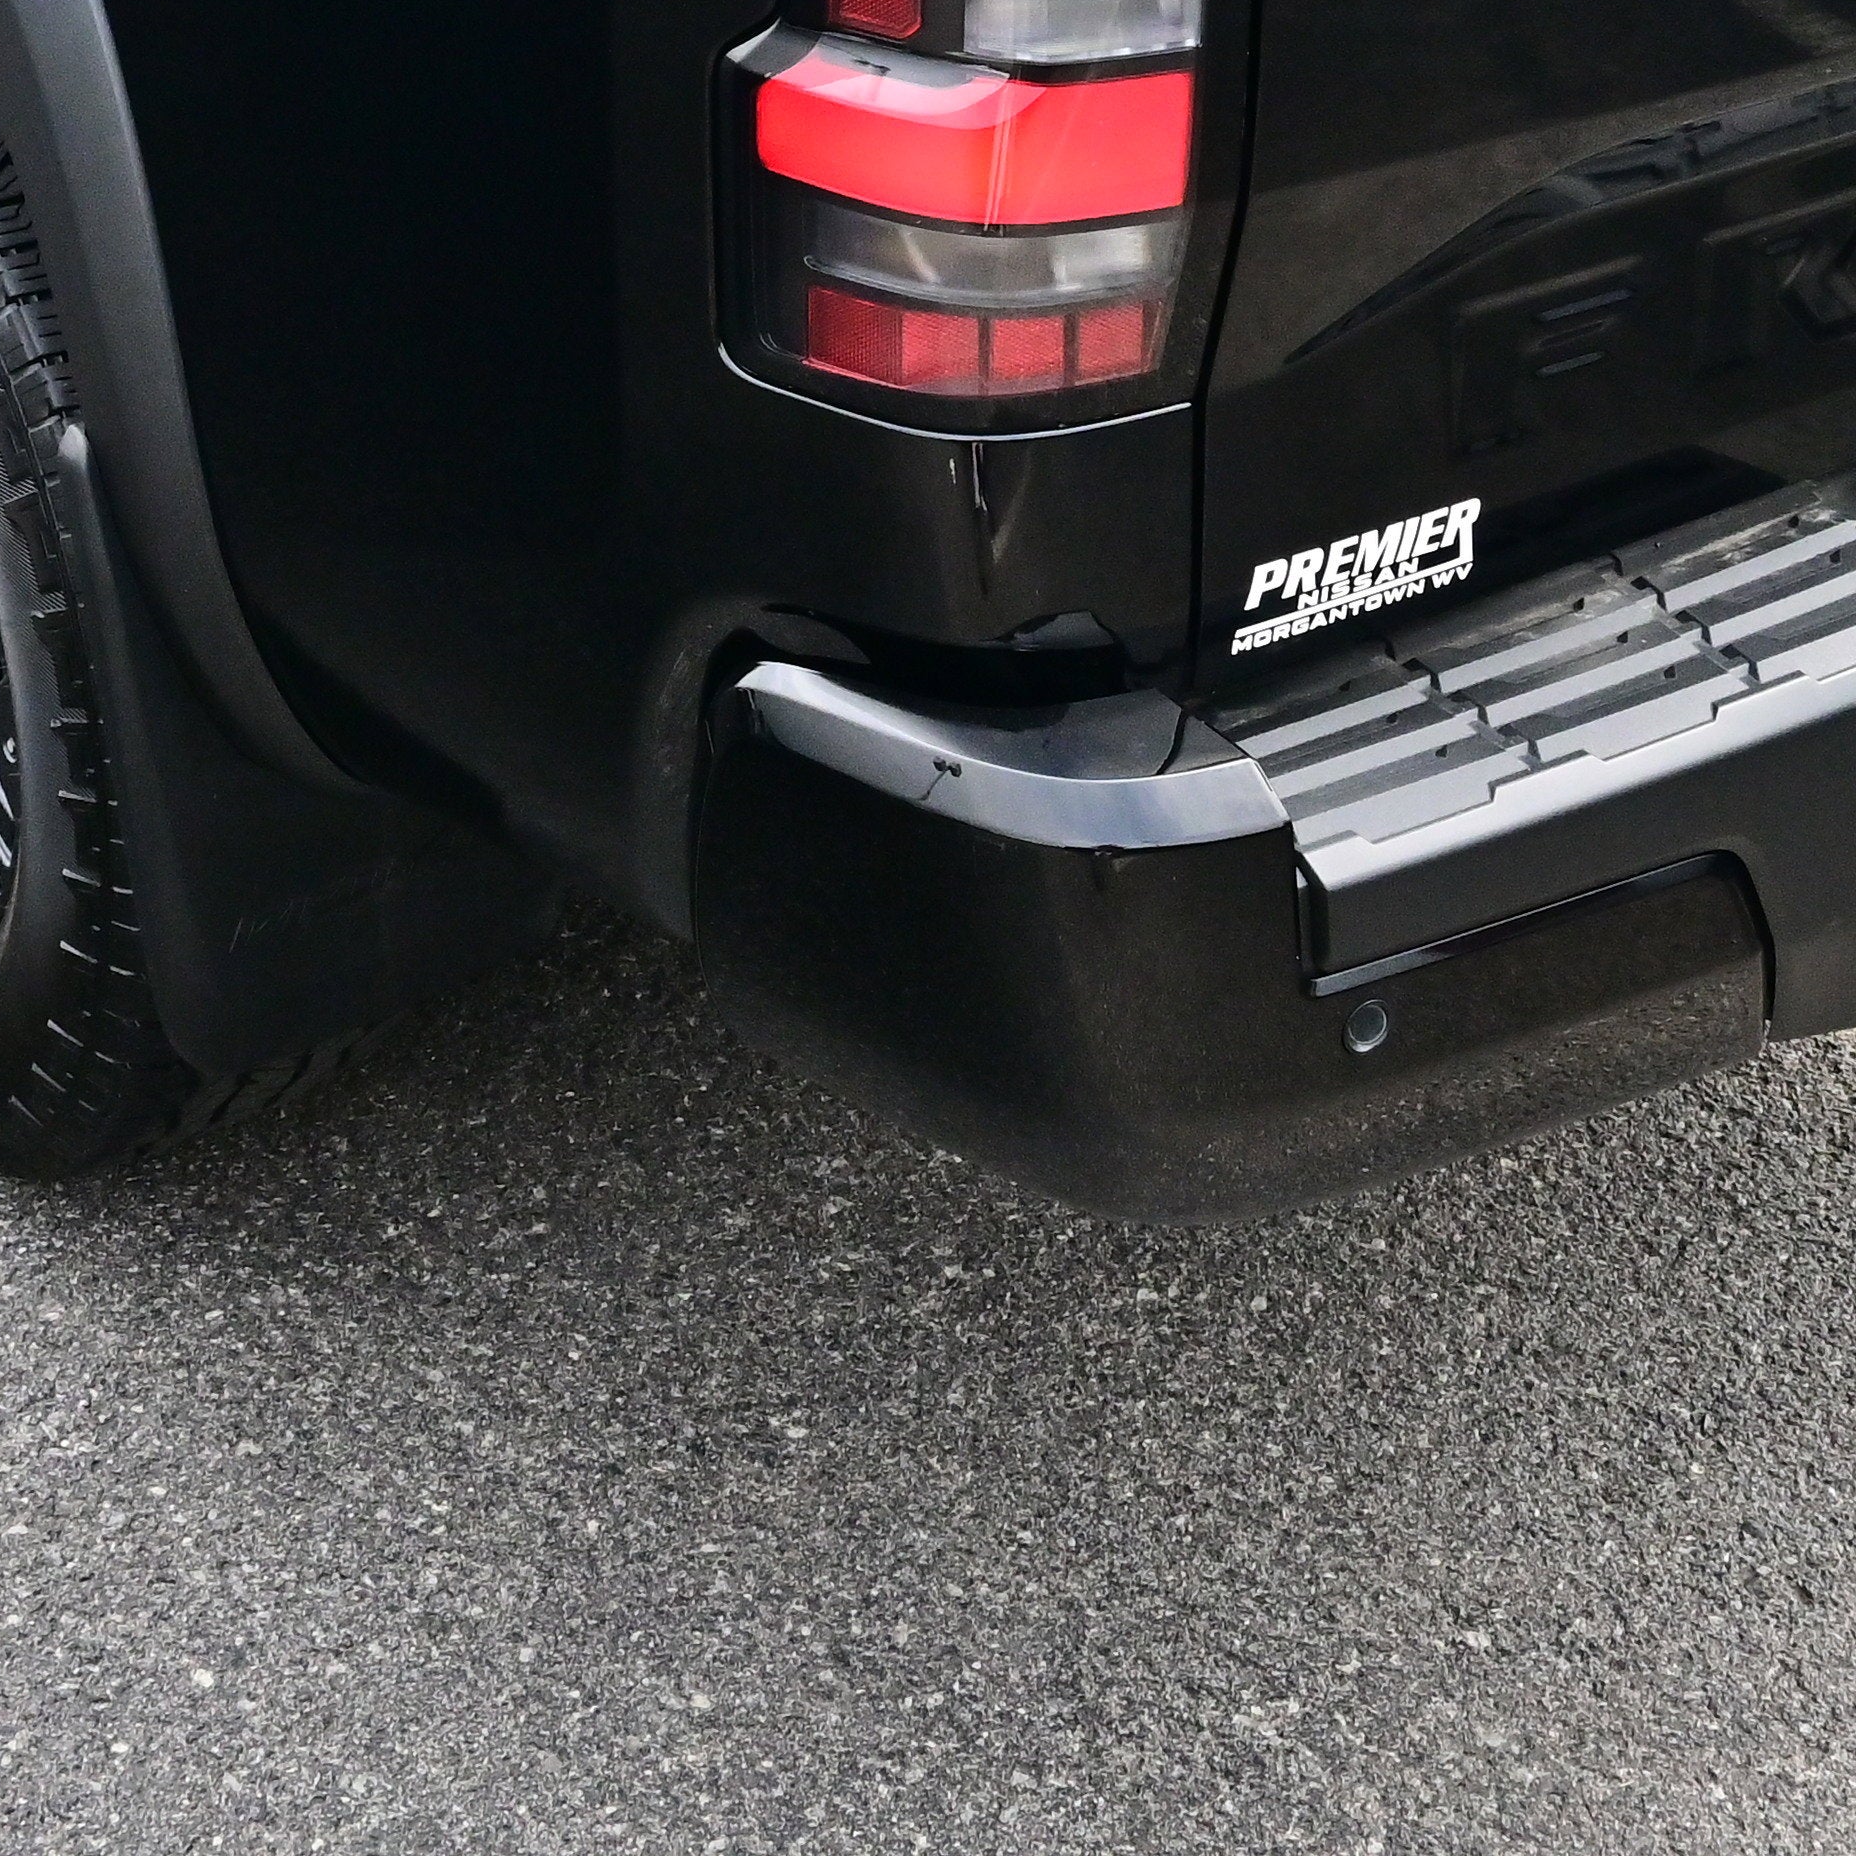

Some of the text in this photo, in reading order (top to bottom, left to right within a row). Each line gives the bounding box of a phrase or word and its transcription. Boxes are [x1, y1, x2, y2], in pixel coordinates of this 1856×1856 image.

[1244, 497, 1482, 611] PREMIER
[1297, 557, 1420, 611] NISSAN
[1231, 562, 1474, 656] MORGANTOWN WV
